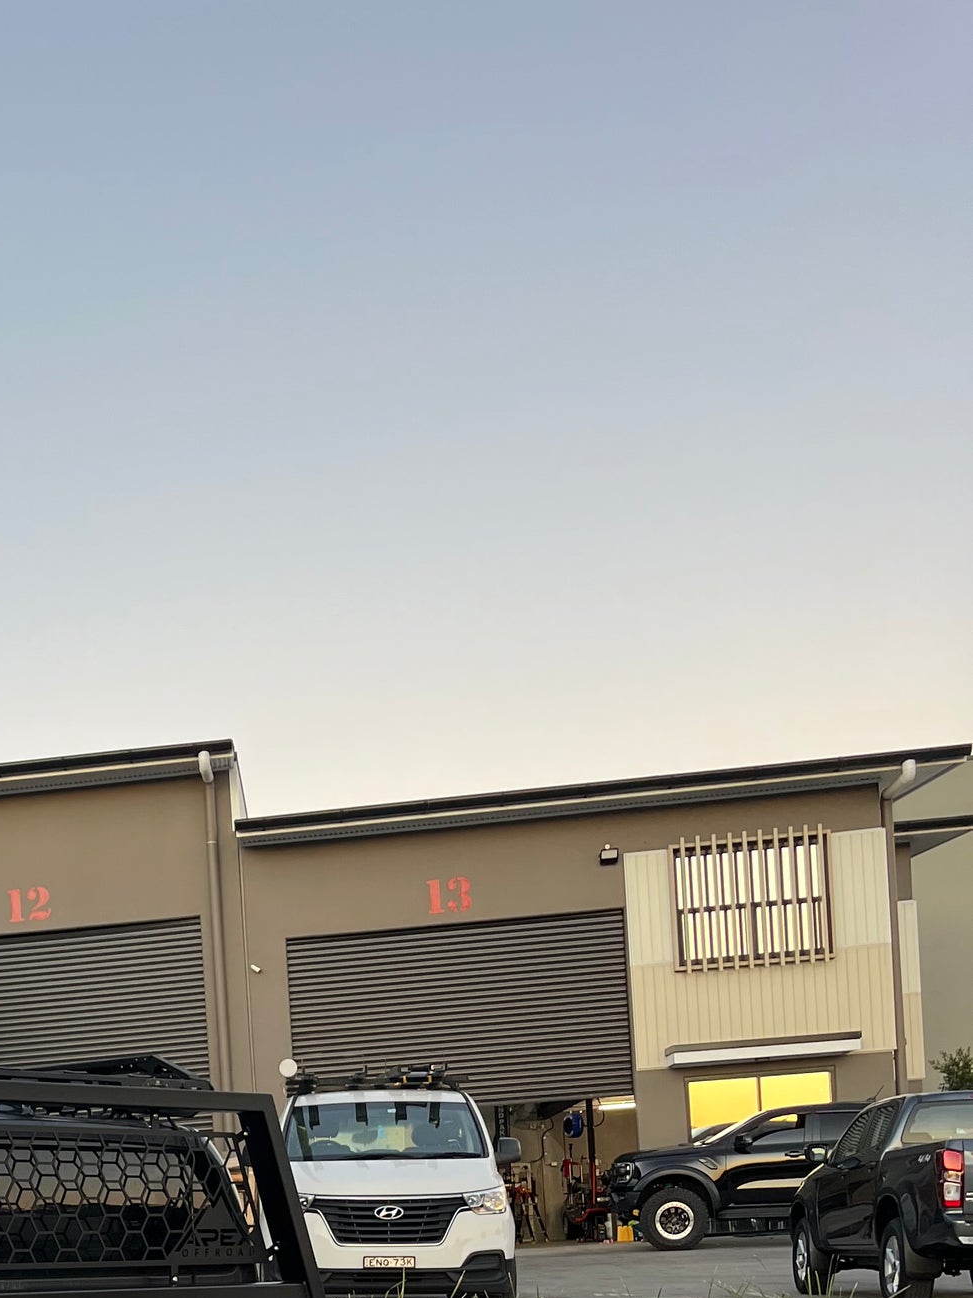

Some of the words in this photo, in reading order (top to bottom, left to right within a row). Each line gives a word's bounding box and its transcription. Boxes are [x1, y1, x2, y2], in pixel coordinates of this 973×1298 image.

[7, 886, 51, 922] 12
[426, 876, 471, 914] 13
[175, 1226, 254, 1252] APEX
